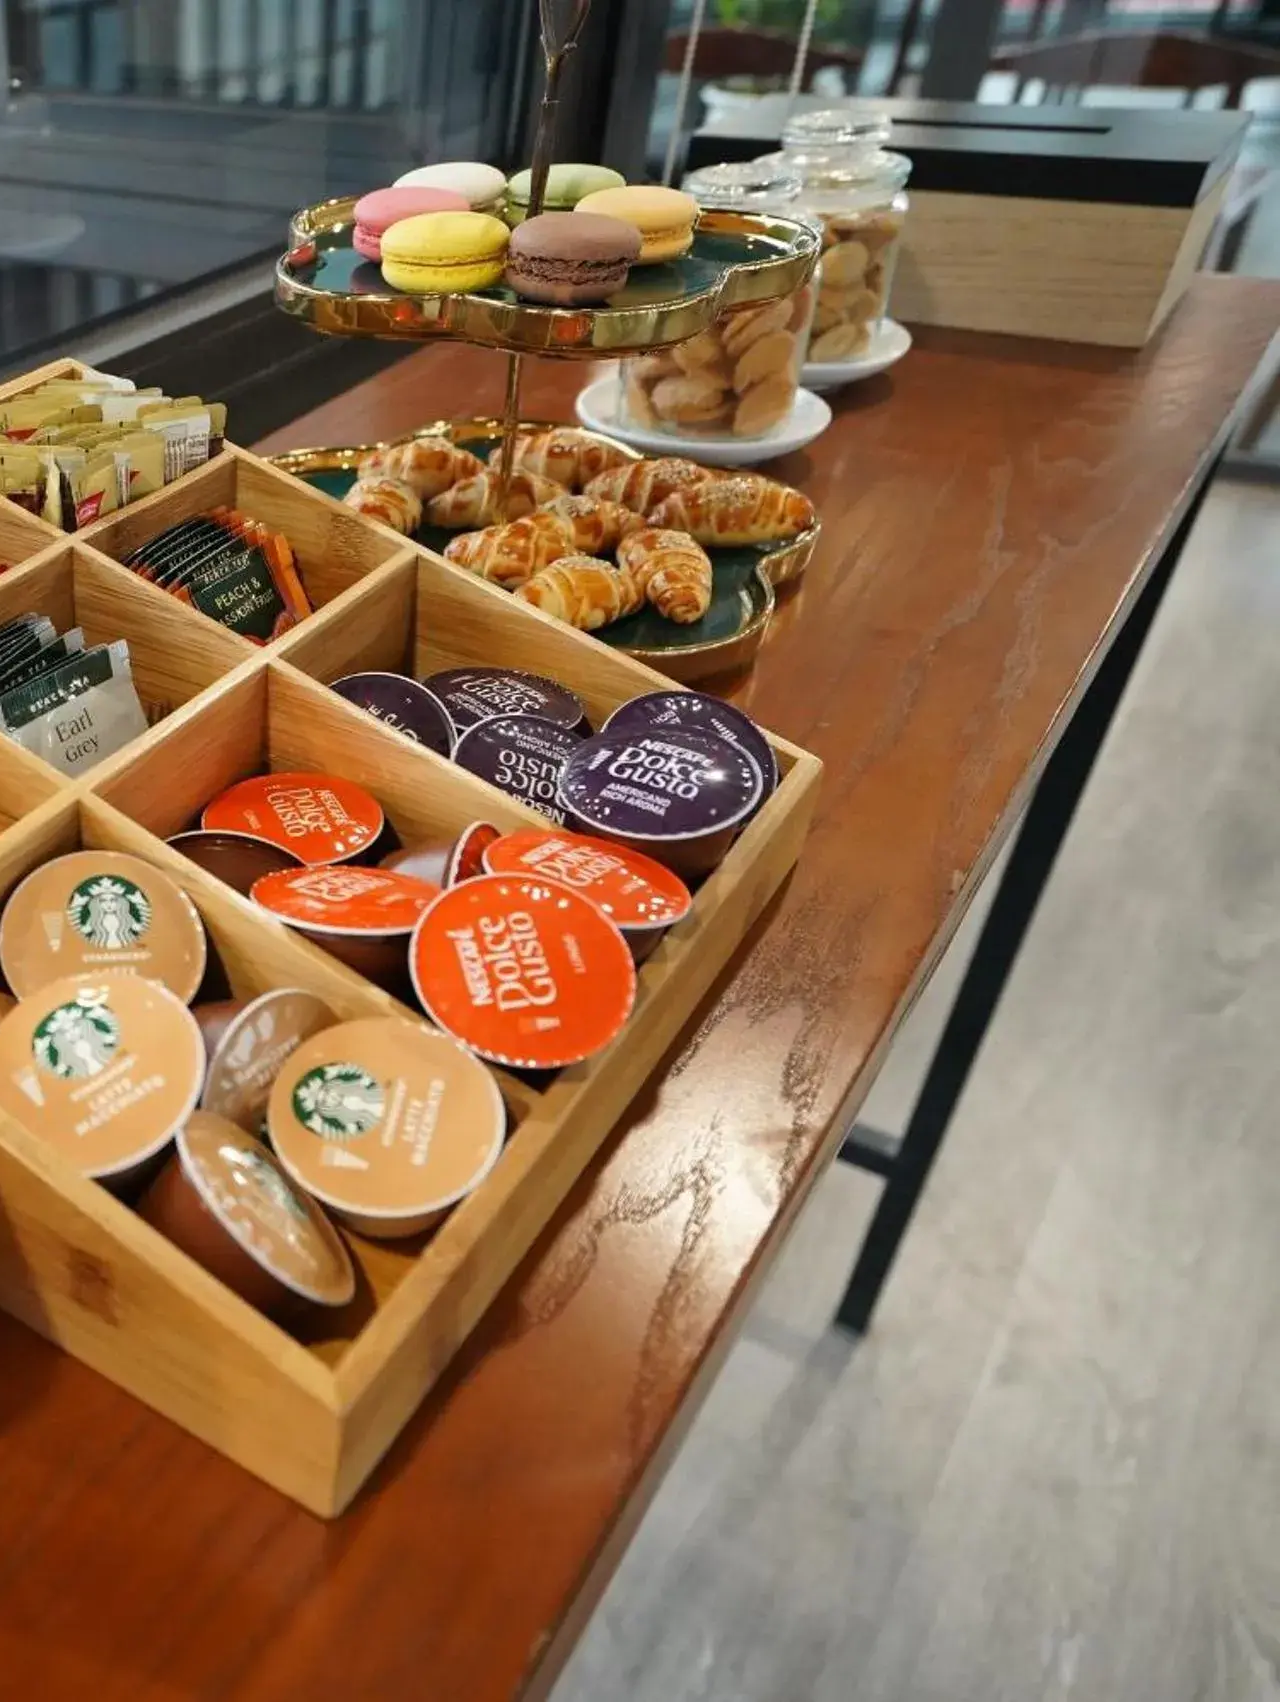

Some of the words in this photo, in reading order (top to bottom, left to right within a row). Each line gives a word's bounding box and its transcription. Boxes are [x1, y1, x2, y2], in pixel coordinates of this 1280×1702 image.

[215, 582, 250, 609] PEACH
[251, 576, 260, 588] &
[219, 601, 254, 627] SSION
[29, 688, 67, 712] BLACK
[55, 707, 93, 744] Earl
[65, 734, 100, 764] Grey
[495, 747, 560, 781] usto
[618, 747, 708, 785] Dolce
[600, 789, 628, 803] RICH
[607, 782, 671, 808] AMERICANO
[608, 760, 698, 800] Gusto
[266, 790, 308, 838] Gusto
[290, 788, 332, 833] Dolce
[477, 915, 531, 1012] Dolce
[507, 911, 557, 1006] Gusto
[401, 1099, 424, 1142] LATTE
[410, 1078, 445, 1166] MACCHIATO
